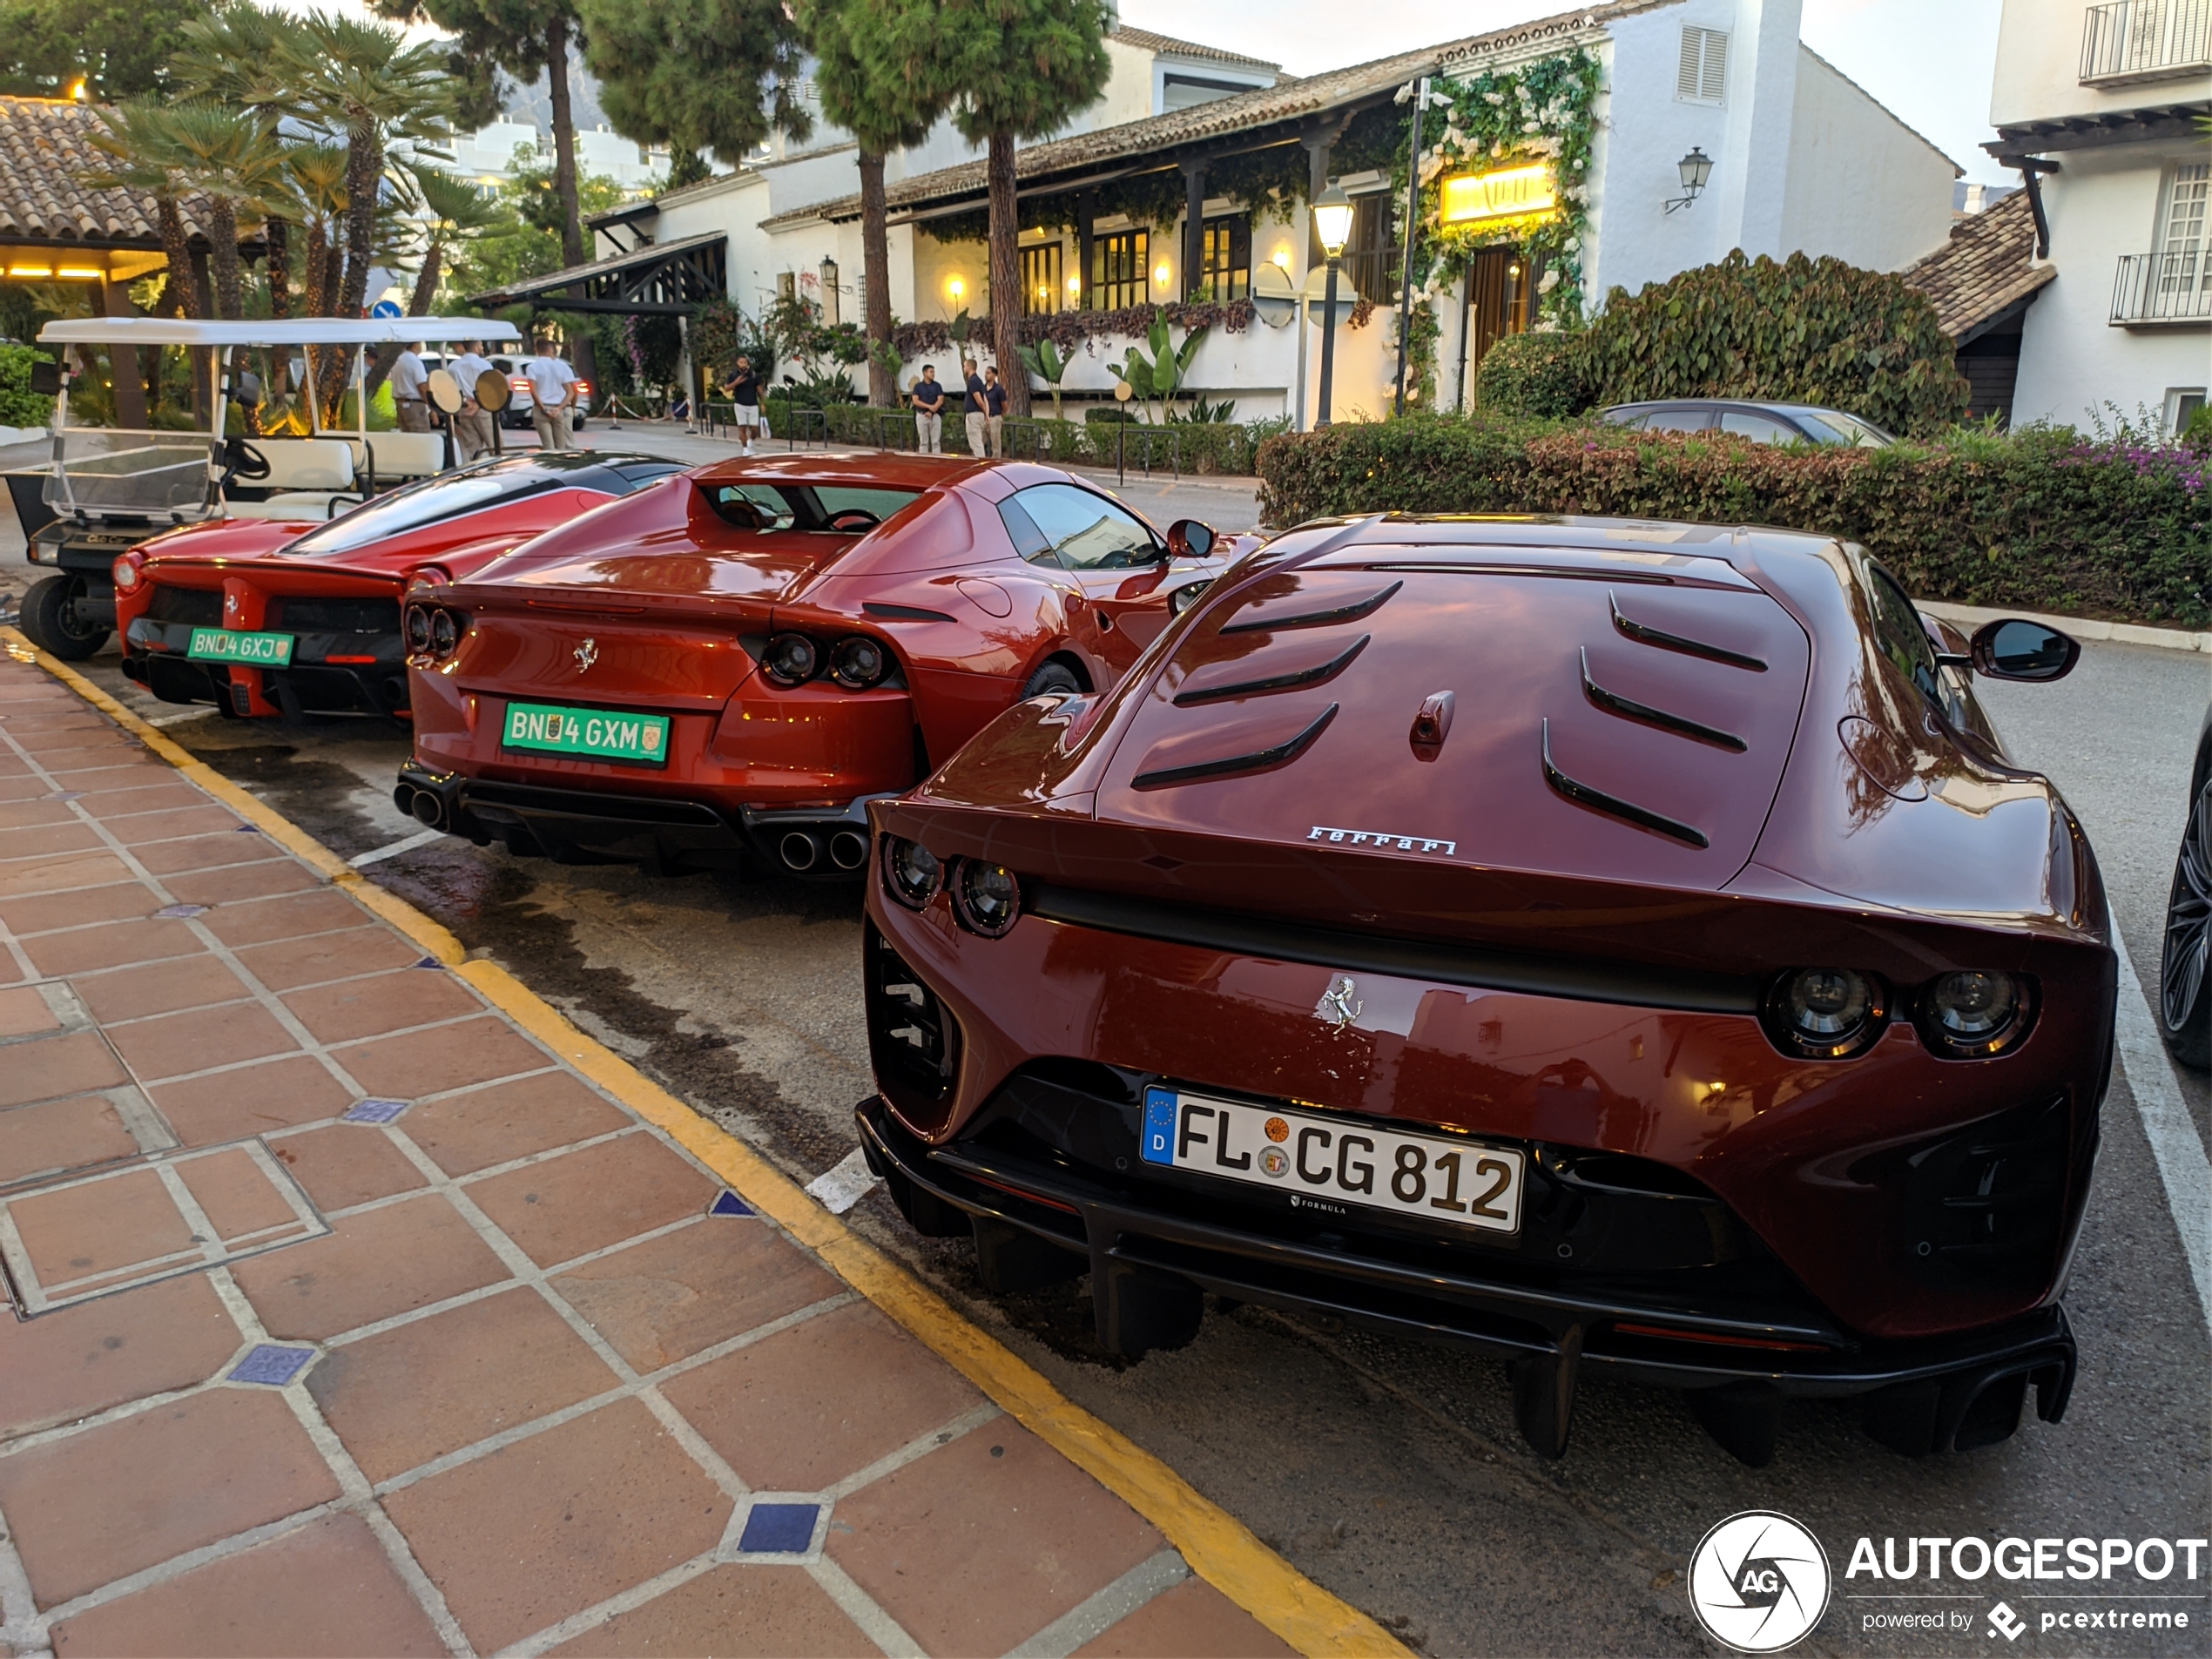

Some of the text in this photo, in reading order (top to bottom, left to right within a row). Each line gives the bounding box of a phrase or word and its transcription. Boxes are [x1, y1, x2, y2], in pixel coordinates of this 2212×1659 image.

[194, 634, 275, 658] BN 4 GXJ
[511, 711, 639, 750] BN 4 GXM
[1306, 826, 1456, 855] Ferrari
[1152, 1134, 1165, 1150] D
[1178, 1104, 1251, 1170] FL
[1297, 1127, 1374, 1195] CG
[1391, 1143, 1512, 1221] 812
[1302, 1200, 1345, 1215] FORMULA
